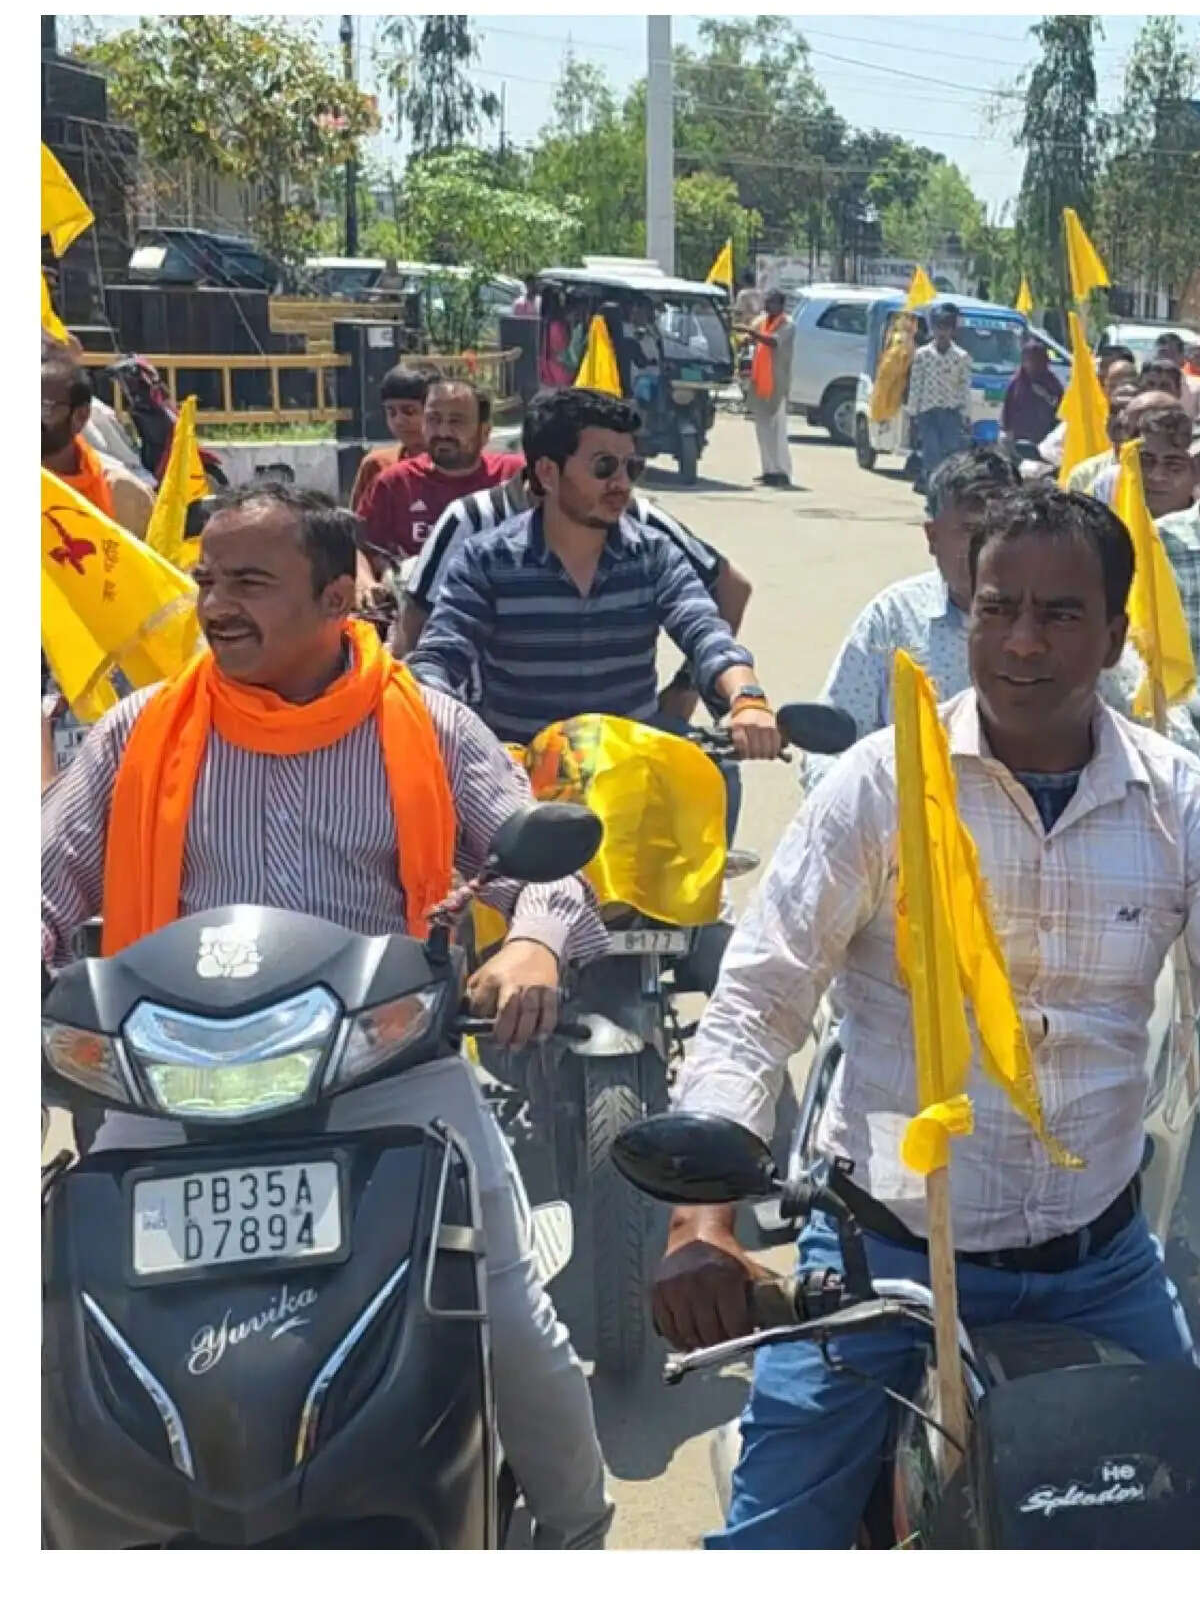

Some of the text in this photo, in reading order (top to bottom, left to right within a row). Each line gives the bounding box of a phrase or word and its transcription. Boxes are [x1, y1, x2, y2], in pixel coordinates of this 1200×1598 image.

[183, 1168, 313, 1218] PB35A
[184, 1211, 314, 1261] D7894
[188, 1282, 318, 1375] Yuvika
